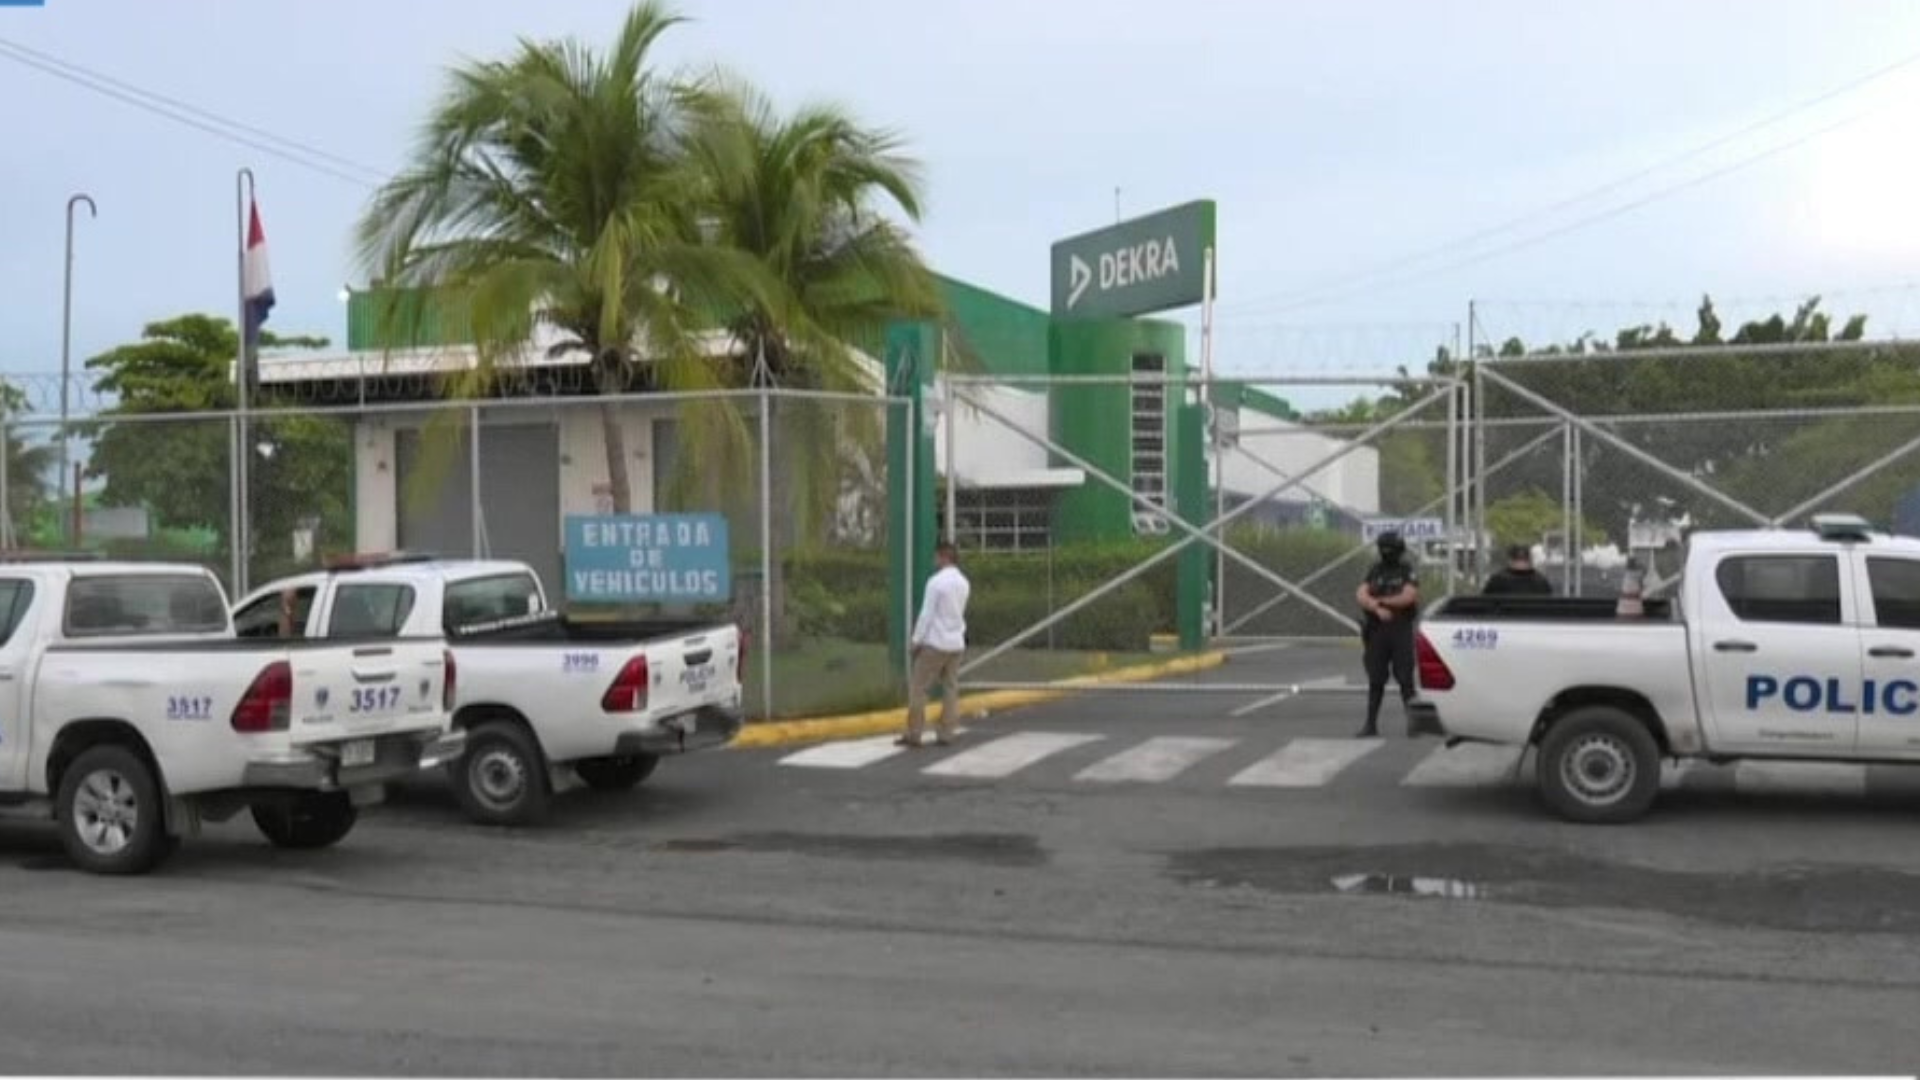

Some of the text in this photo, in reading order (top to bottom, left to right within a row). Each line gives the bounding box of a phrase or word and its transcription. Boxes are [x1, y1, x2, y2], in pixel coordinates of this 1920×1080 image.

[1099, 235, 1179, 290] DEKRA
[582, 521, 711, 547] ENTRADA
[629, 549, 663, 568] DE
[574, 570, 718, 595] VEHICULOS
[1452, 628, 1497, 642] 4269
[167, 695, 213, 714] 3517
[349, 686, 401, 713] 3517
